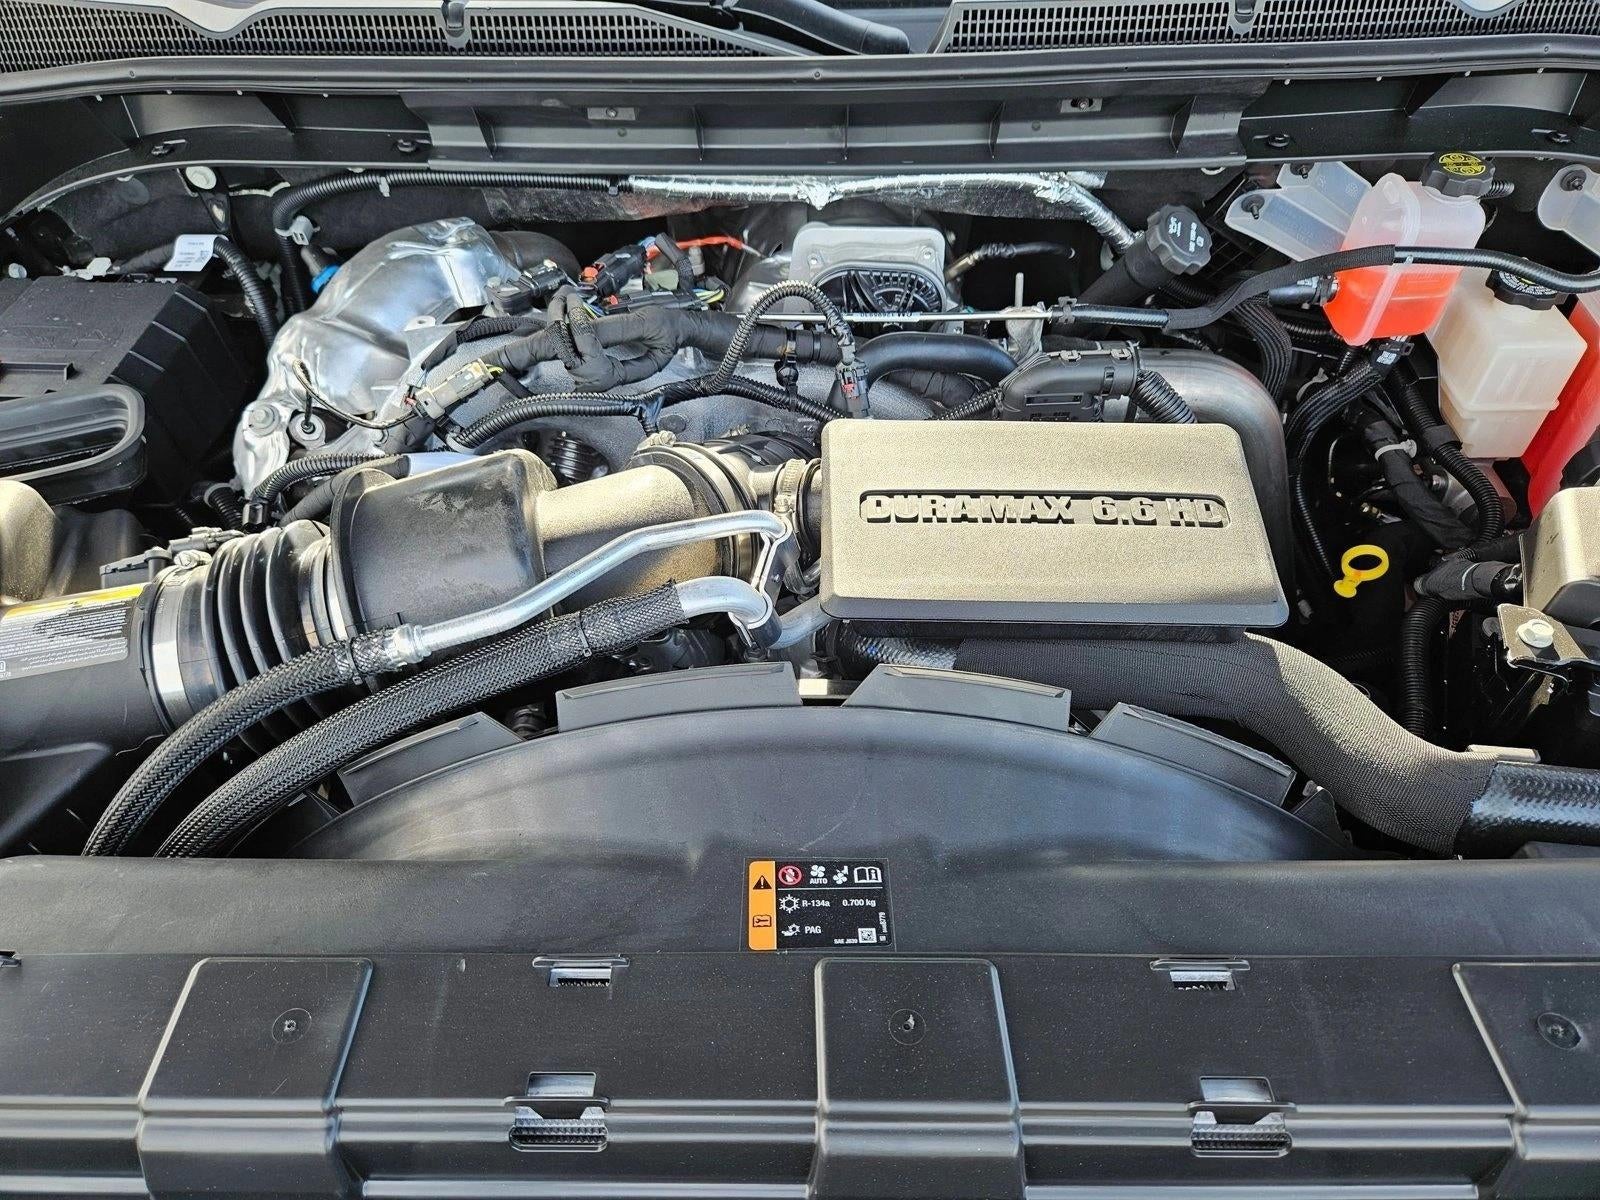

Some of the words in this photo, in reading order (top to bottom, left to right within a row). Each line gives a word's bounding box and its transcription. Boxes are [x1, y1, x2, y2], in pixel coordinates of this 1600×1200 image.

[865, 494, 1075, 524] DURAMAX
[1090, 496, 1157, 525] 6.6
[1165, 497, 1224, 528] HD
[801, 899, 831, 907] R-134a
[842, 898, 865, 907] 0.700
[865, 898, 876, 908] kg
[804, 925, 822, 934] PAG
